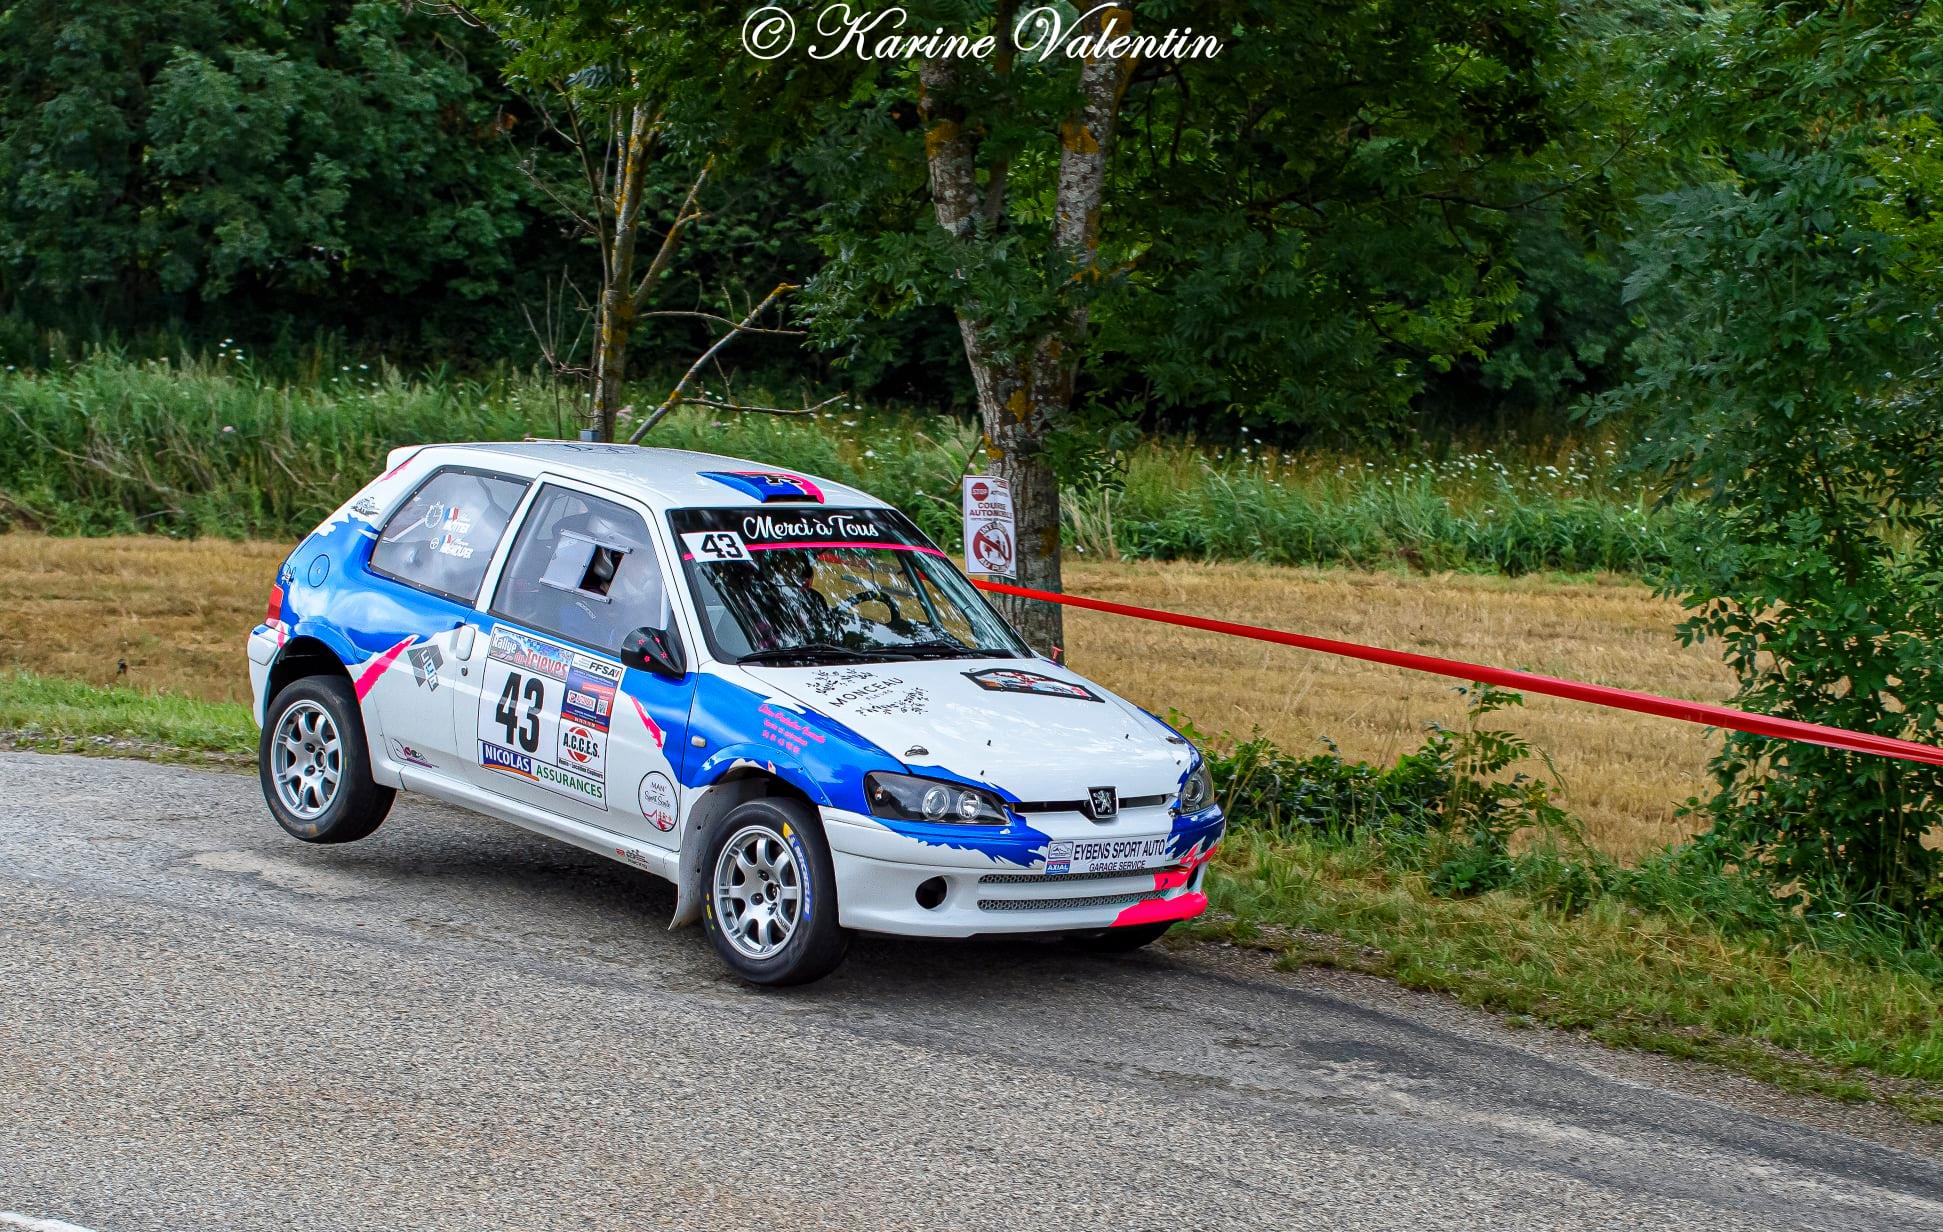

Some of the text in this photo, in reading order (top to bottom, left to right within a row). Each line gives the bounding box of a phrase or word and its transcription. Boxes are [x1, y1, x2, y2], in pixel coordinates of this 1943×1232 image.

[743, 515, 879, 540] Merci à Tous
[701, 533, 744, 559] 43
[491, 634, 518, 655] Rallye
[589, 661, 616, 678] FFSA
[828, 677, 905, 708] MONCEAU
[495, 671, 545, 754] 43
[563, 732, 600, 759] A.C.C.E.S.
[485, 744, 603, 799] NICOLAS ASSURANCES
[1073, 842, 1111, 860] EYBENS
[1112, 840, 1143, 859] SPORT
[1143, 838, 1165, 856] AUTO
[1089, 859, 1146, 872] GARAGE SERVICE
